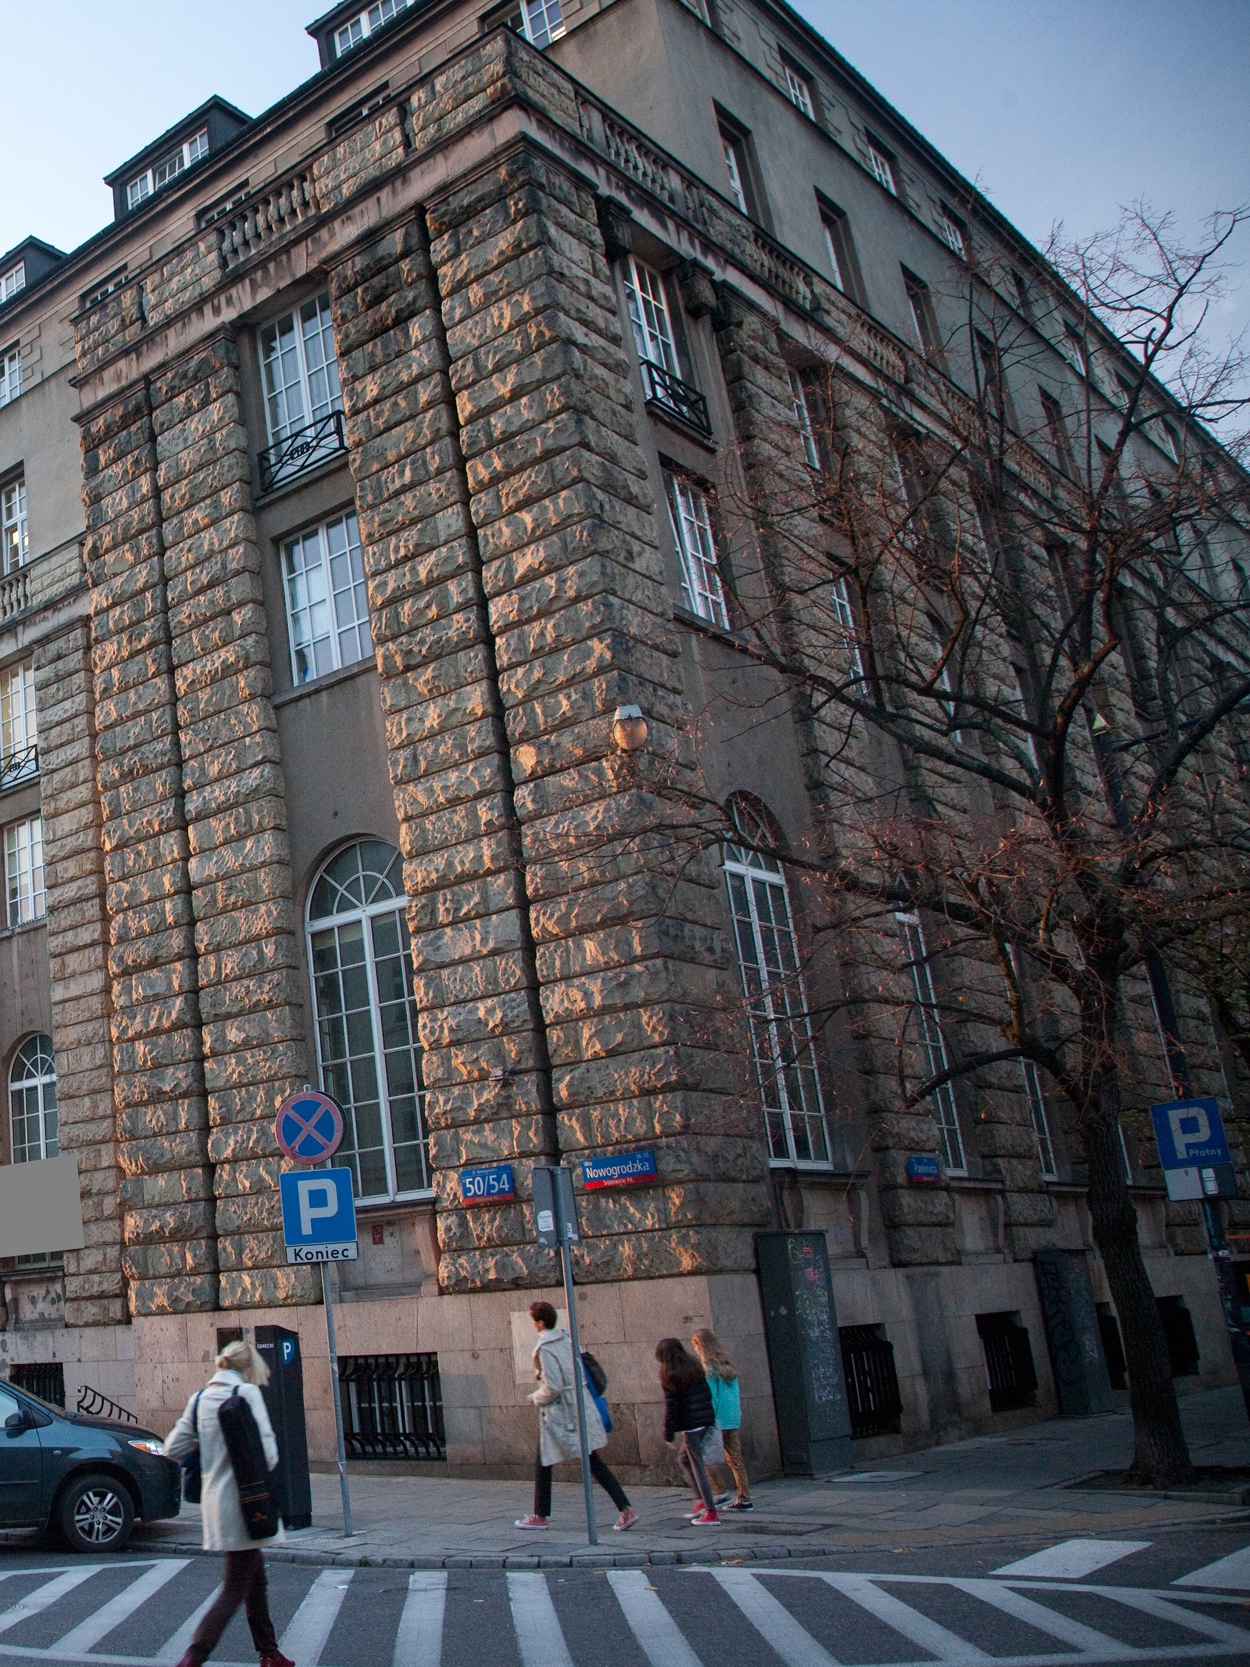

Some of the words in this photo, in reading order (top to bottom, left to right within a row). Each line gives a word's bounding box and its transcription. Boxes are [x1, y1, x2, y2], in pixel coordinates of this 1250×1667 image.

[1166, 1106, 1211, 1159] P
[1188, 1148, 1222, 1158] Płatny
[586, 1159, 650, 1179] Nowogrodzka
[465, 1173, 510, 1197] 50/54
[297, 1178, 339, 1236] P
[293, 1245, 350, 1262] Koniec
[283, 1342, 292, 1360] P
